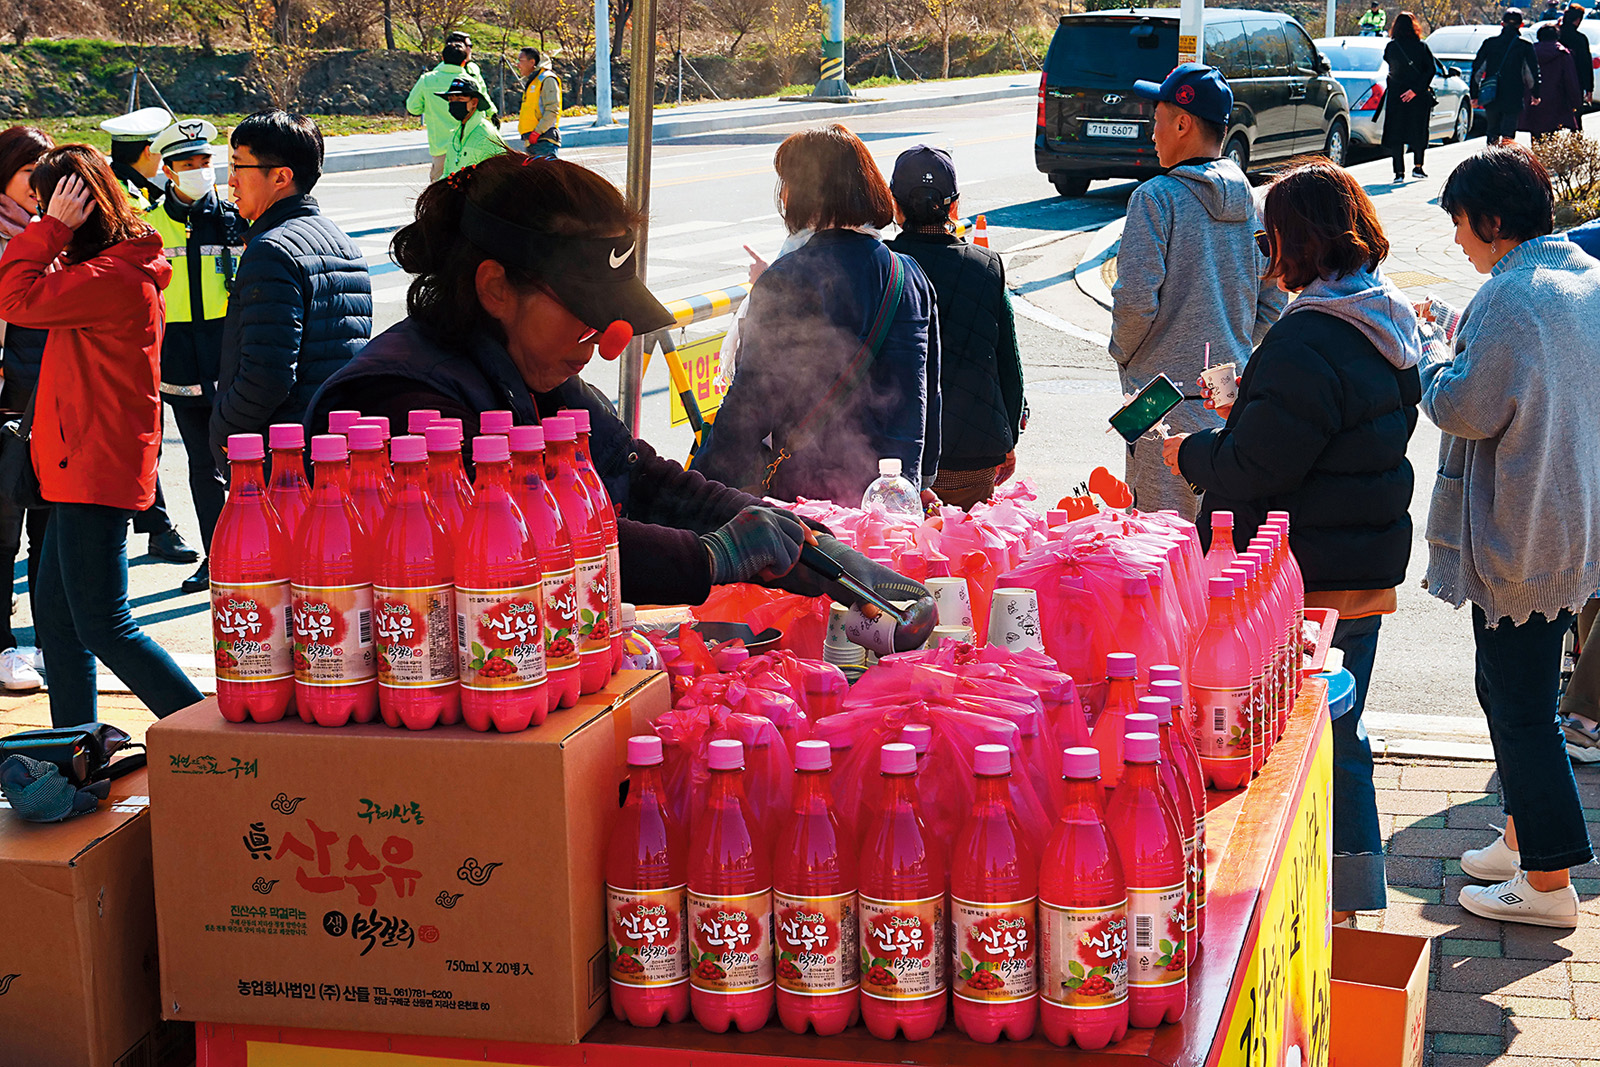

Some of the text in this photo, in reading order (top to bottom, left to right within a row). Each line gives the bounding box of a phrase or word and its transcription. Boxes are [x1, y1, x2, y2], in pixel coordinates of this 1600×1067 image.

[1111, 125, 1134, 136] 5607
[216, 606, 262, 638] 산수유
[294, 608, 335, 641] 산수유
[376, 609, 415, 643] 산수유
[489, 612, 538, 642] 산수유
[169, 753, 191, 768] 자연
[227, 757, 258, 780] 구례
[274, 818, 423, 907] 산수유
[230, 905, 307, 920] 진산수유 막걸리는
[620, 912, 670, 943] 산수유
[351, 908, 415, 957] 막걸리
[701, 918, 751, 950] 산수유
[781, 918, 830, 951] 산수유
[873, 923, 925, 956] 산수유
[977, 926, 1028, 958] 산수유
[445, 959, 480, 973] 750ml
[482, 961, 493, 974] X
[640, 943, 668, 964] 막걸리
[722, 950, 750, 971] 막걸리
[799, 950, 827, 971] 막걸리
[894, 955, 922, 976] 막걸리
[237, 979, 370, 1003] 농업회사법인 (주) 산들
[374, 996, 388, 1005] 전남
[480, 1002, 491, 1010] 60
